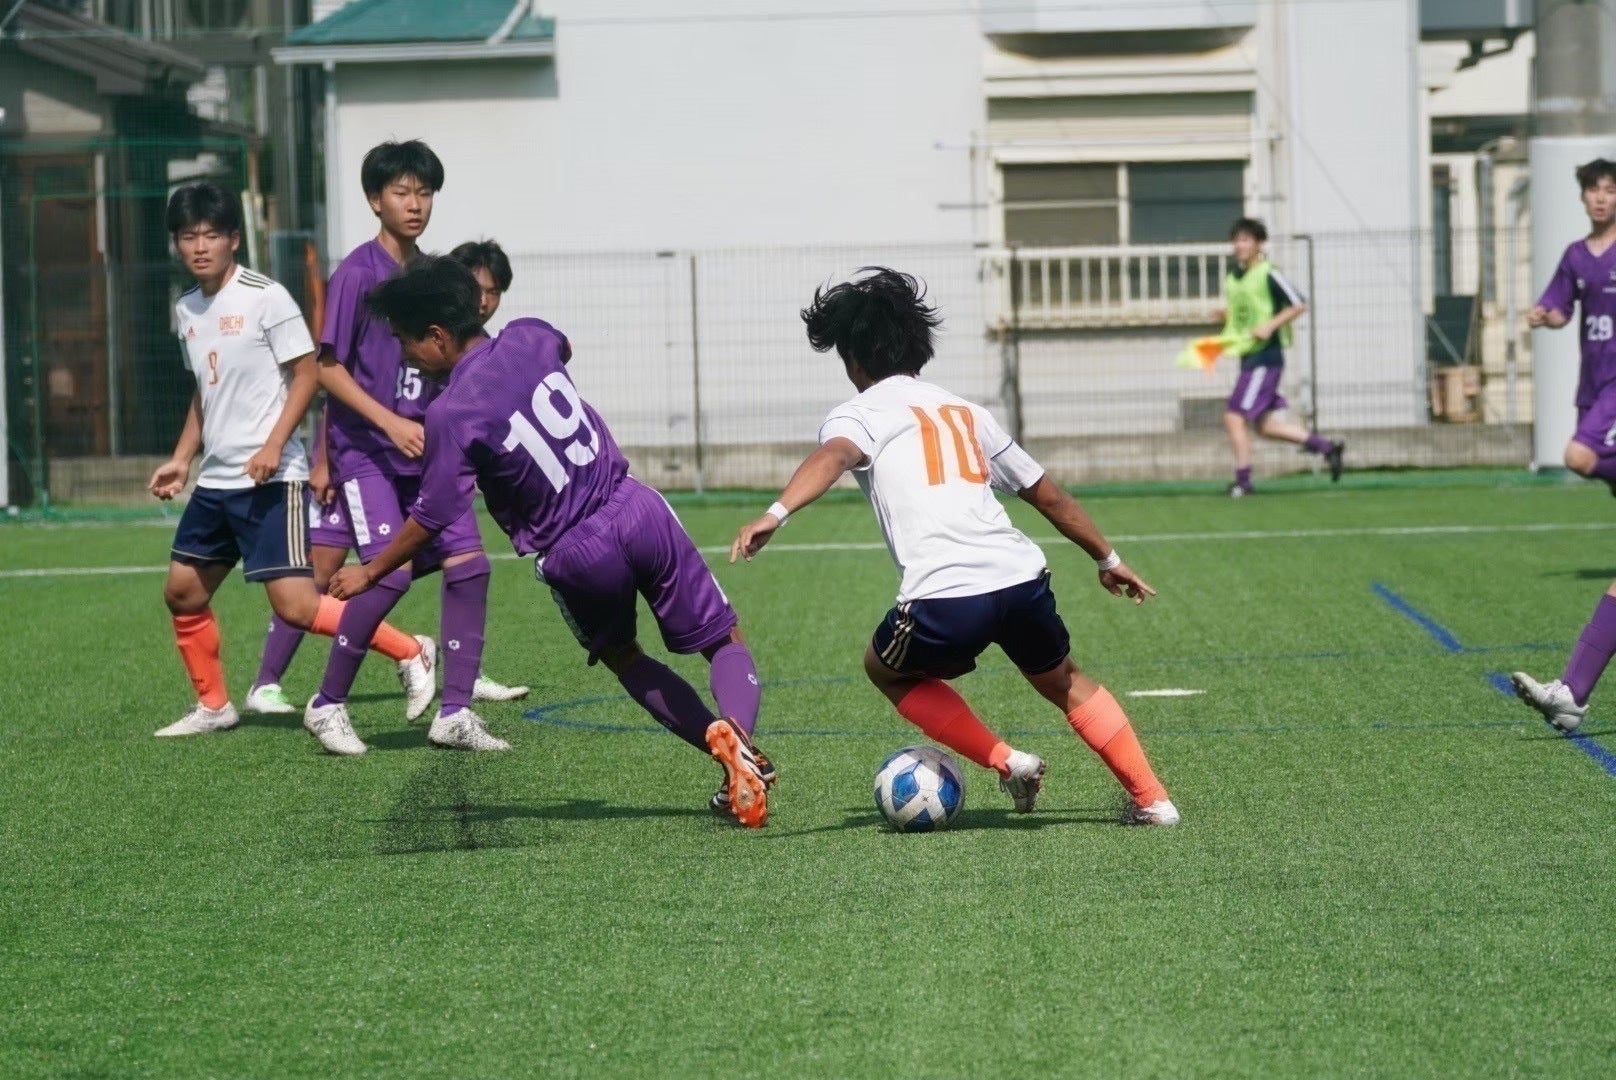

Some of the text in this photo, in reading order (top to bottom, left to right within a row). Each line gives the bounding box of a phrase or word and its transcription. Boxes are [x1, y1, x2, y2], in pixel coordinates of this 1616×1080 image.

[1585, 315, 1613, 341] 29
[208, 351, 218, 385] 9
[502, 371, 599, 494] 19
[907, 404, 989, 486] 10
